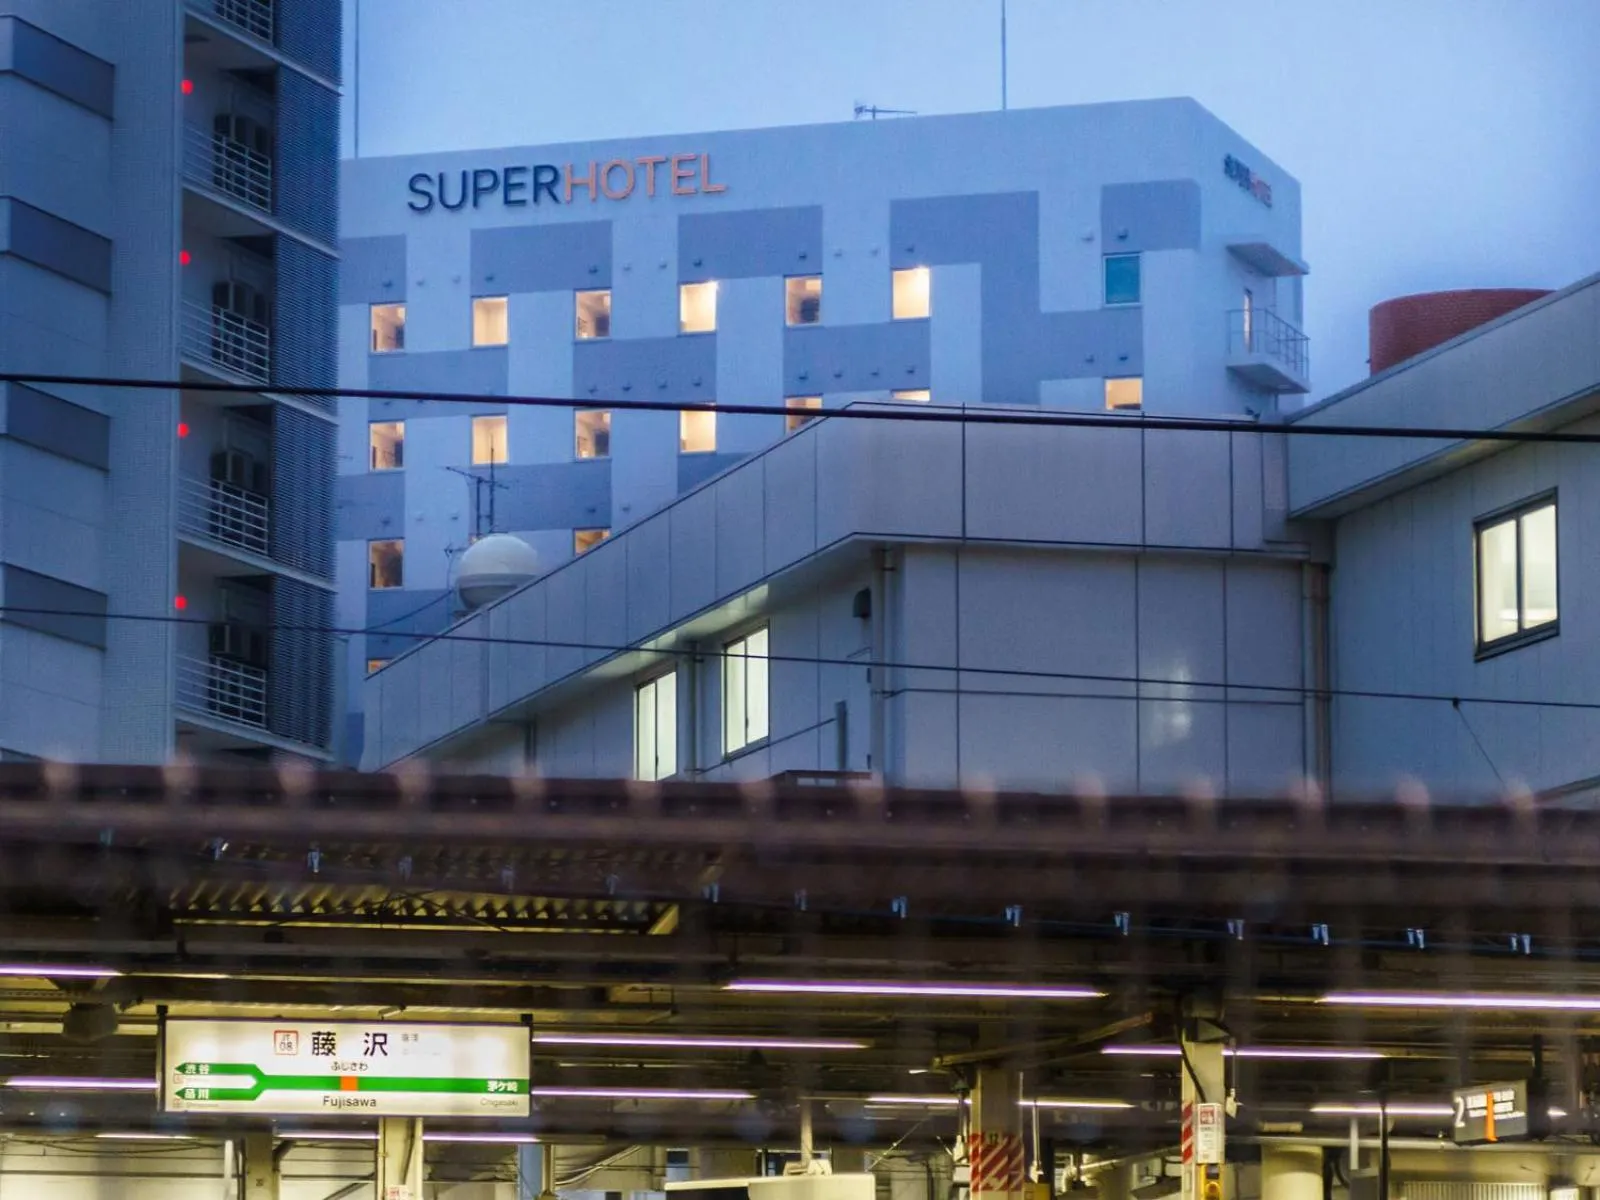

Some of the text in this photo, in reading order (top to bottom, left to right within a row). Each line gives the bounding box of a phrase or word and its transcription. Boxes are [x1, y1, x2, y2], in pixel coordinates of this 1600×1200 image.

[311, 1031, 389, 1057] 藤沢
[331, 1061, 369, 1073] ふじさわ
[323, 1095, 377, 1109] Fujisawa
[1454, 1096, 1466, 1128] 2
